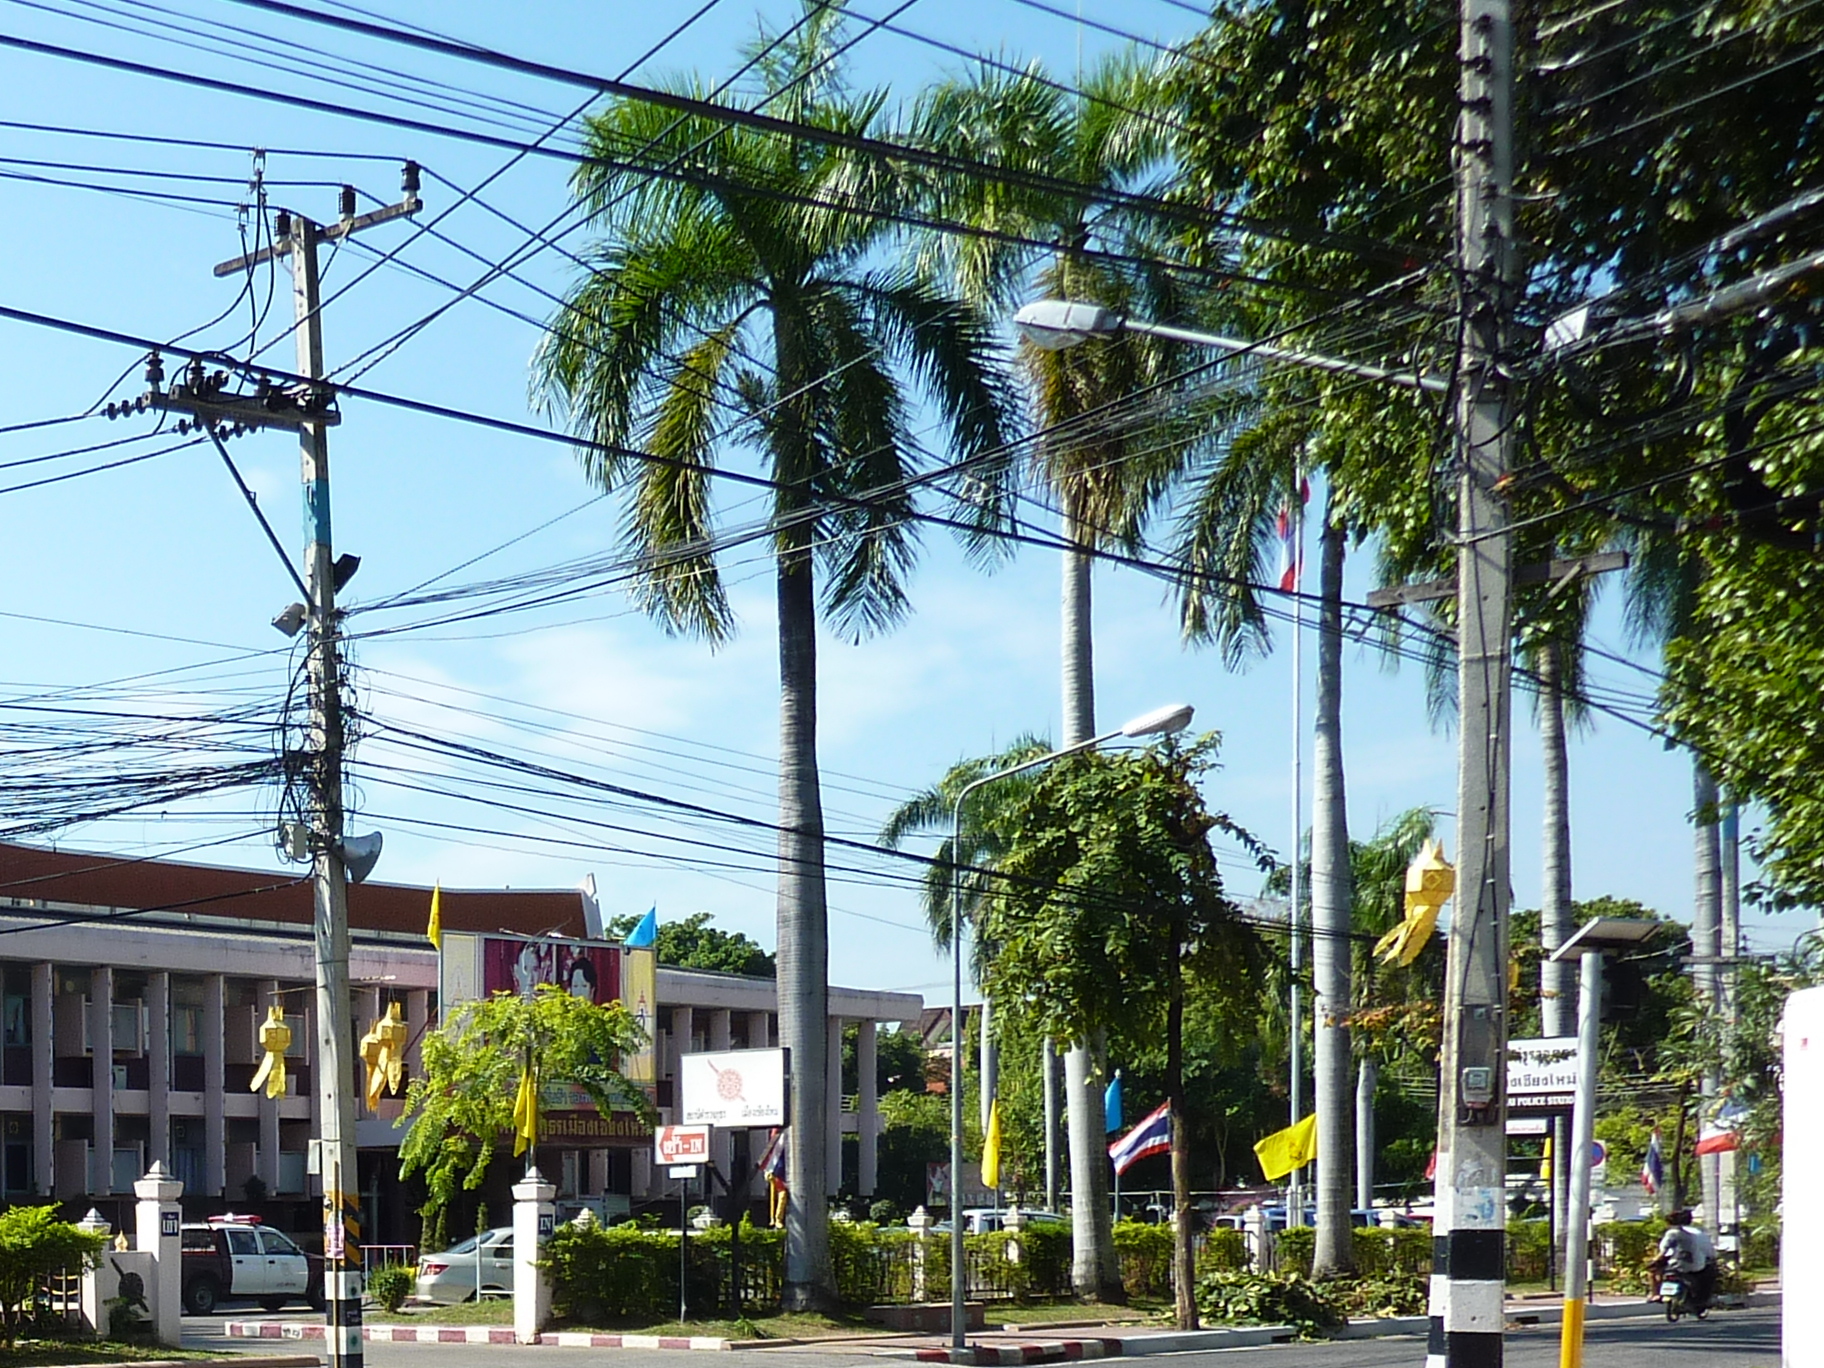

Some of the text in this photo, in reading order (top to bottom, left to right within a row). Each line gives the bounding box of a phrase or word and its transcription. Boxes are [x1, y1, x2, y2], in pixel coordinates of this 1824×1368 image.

[1517, 1096, 1546, 1106] POLICE
[1547, 1095, 1575, 1106] STATIO
[540, 1217, 552, 1230] IN
